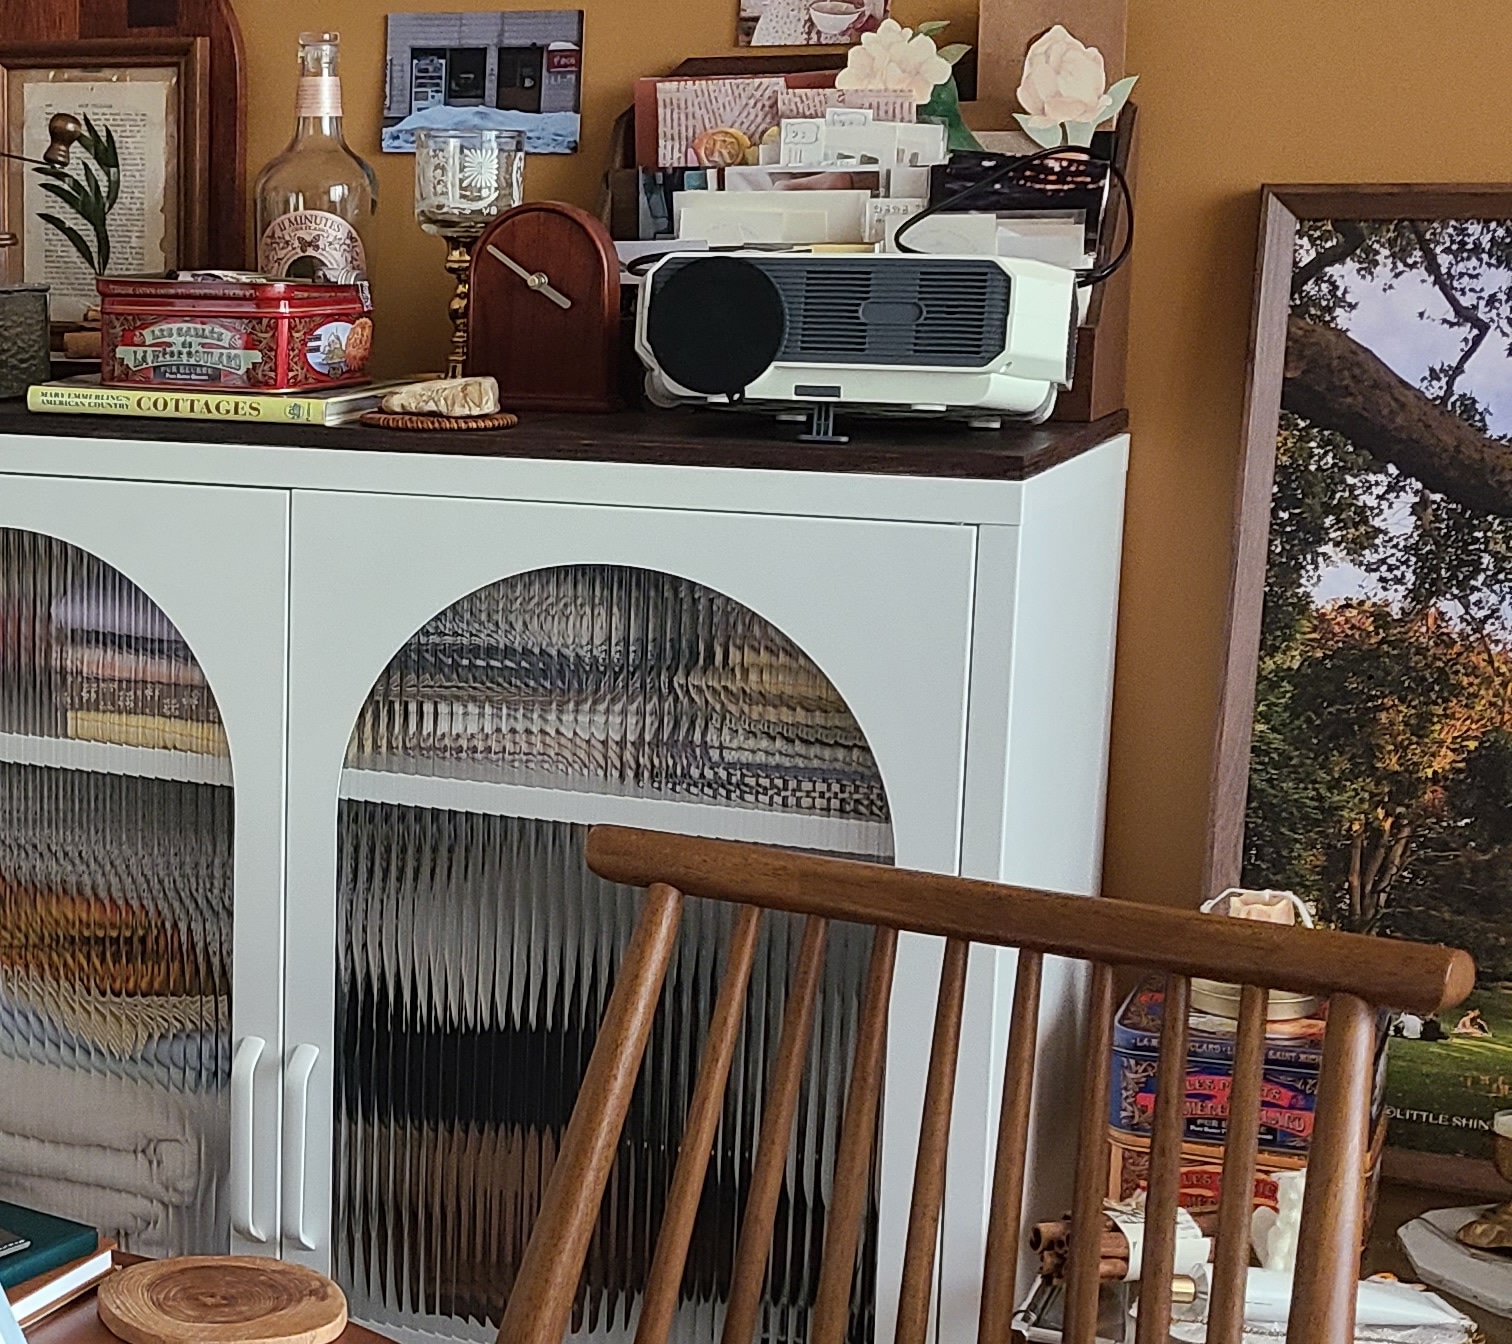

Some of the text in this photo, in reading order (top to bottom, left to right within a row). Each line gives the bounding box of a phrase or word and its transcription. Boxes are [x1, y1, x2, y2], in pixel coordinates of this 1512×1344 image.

[287, 215, 343, 233] MINUTES
[40, 391, 65, 399] MARY
[41, 399, 131, 410] AMERICAN COUNTRY
[136, 396, 261, 418] COTTAGES
[1452, 1116, 1493, 1130] SHIN
